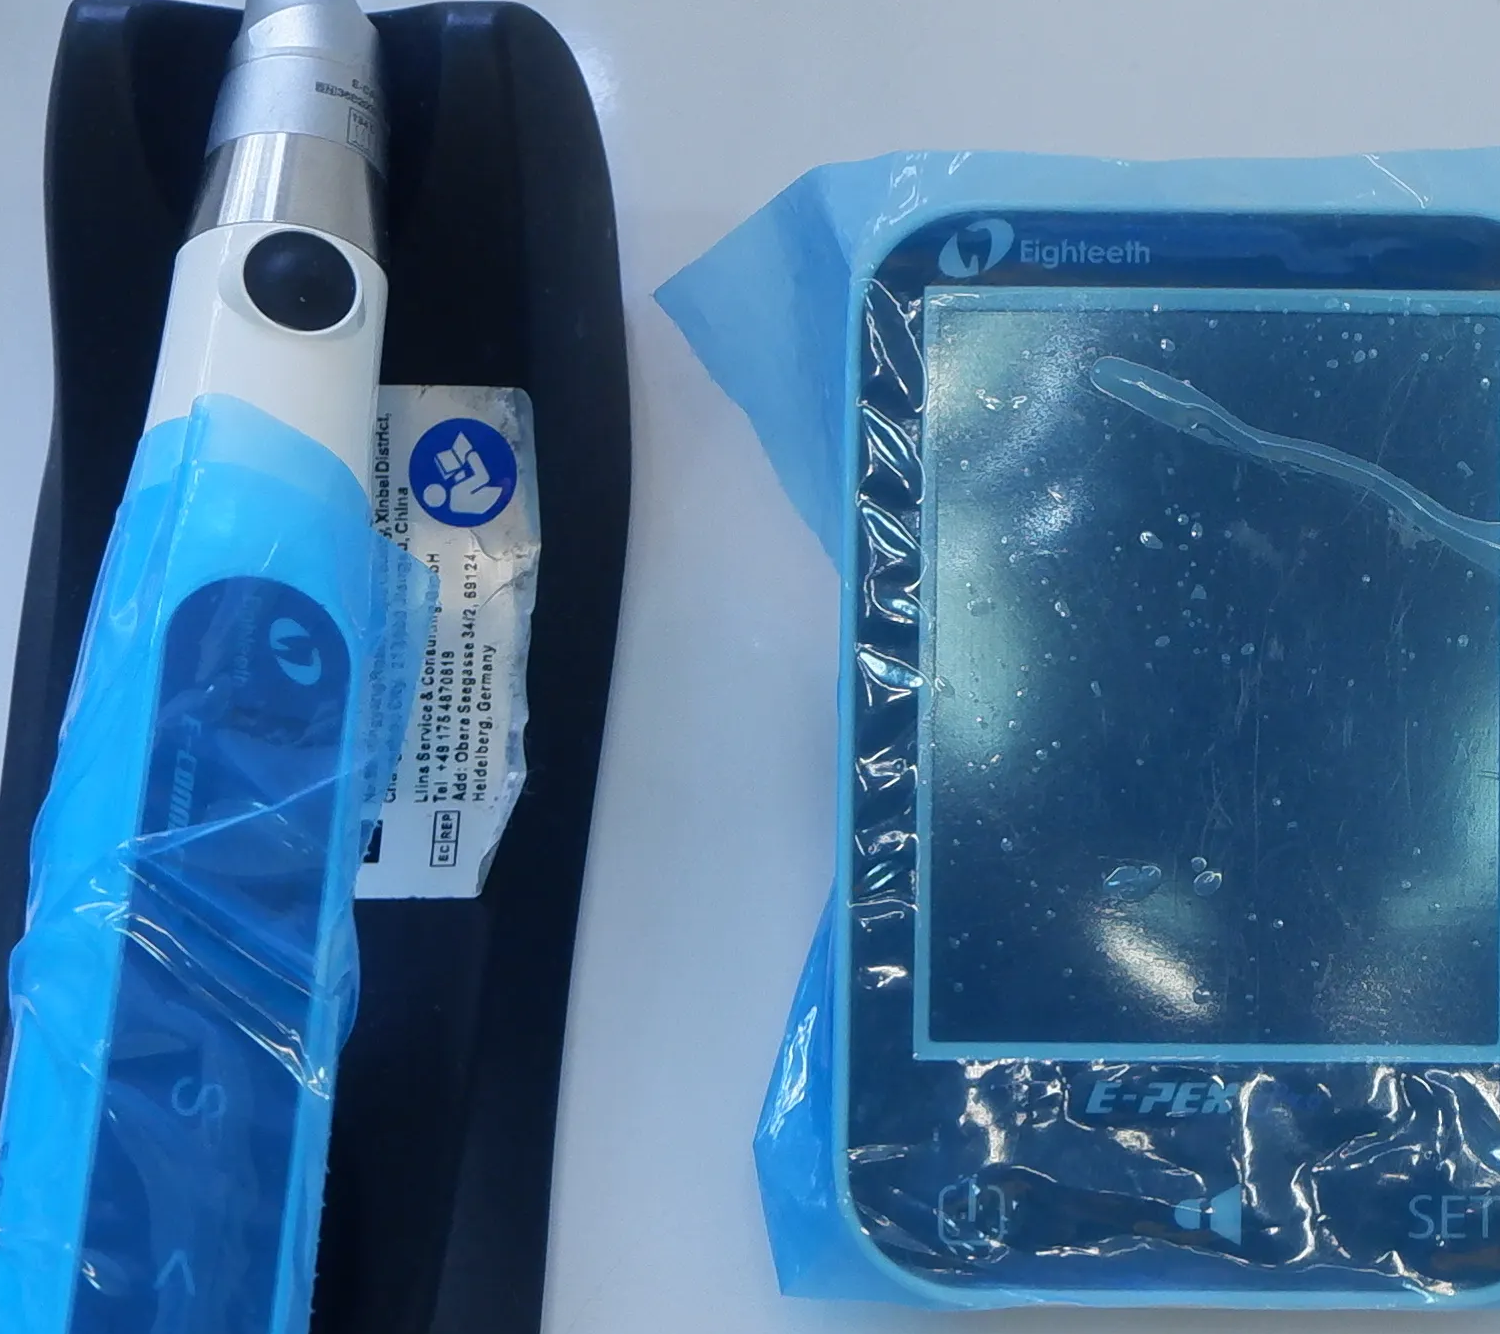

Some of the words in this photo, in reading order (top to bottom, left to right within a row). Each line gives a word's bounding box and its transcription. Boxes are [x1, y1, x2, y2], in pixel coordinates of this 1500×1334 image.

[1019, 238, 1151, 267] Eighteeth
[394, 486, 409, 534] China
[420, 690, 434, 702] &
[457, 641, 477, 714] Seegasse
[476, 644, 498, 713] Germany
[416, 705, 432, 762] Service
[455, 717, 471, 765] Obere
[435, 745, 451, 772] +49
[472, 716, 494, 803] Heidelberg,
[452, 768, 469, 803] Add:
[440, 813, 454, 841] REP
[437, 843, 451, 863] EC
[1406, 1192, 1495, 1241] SET
